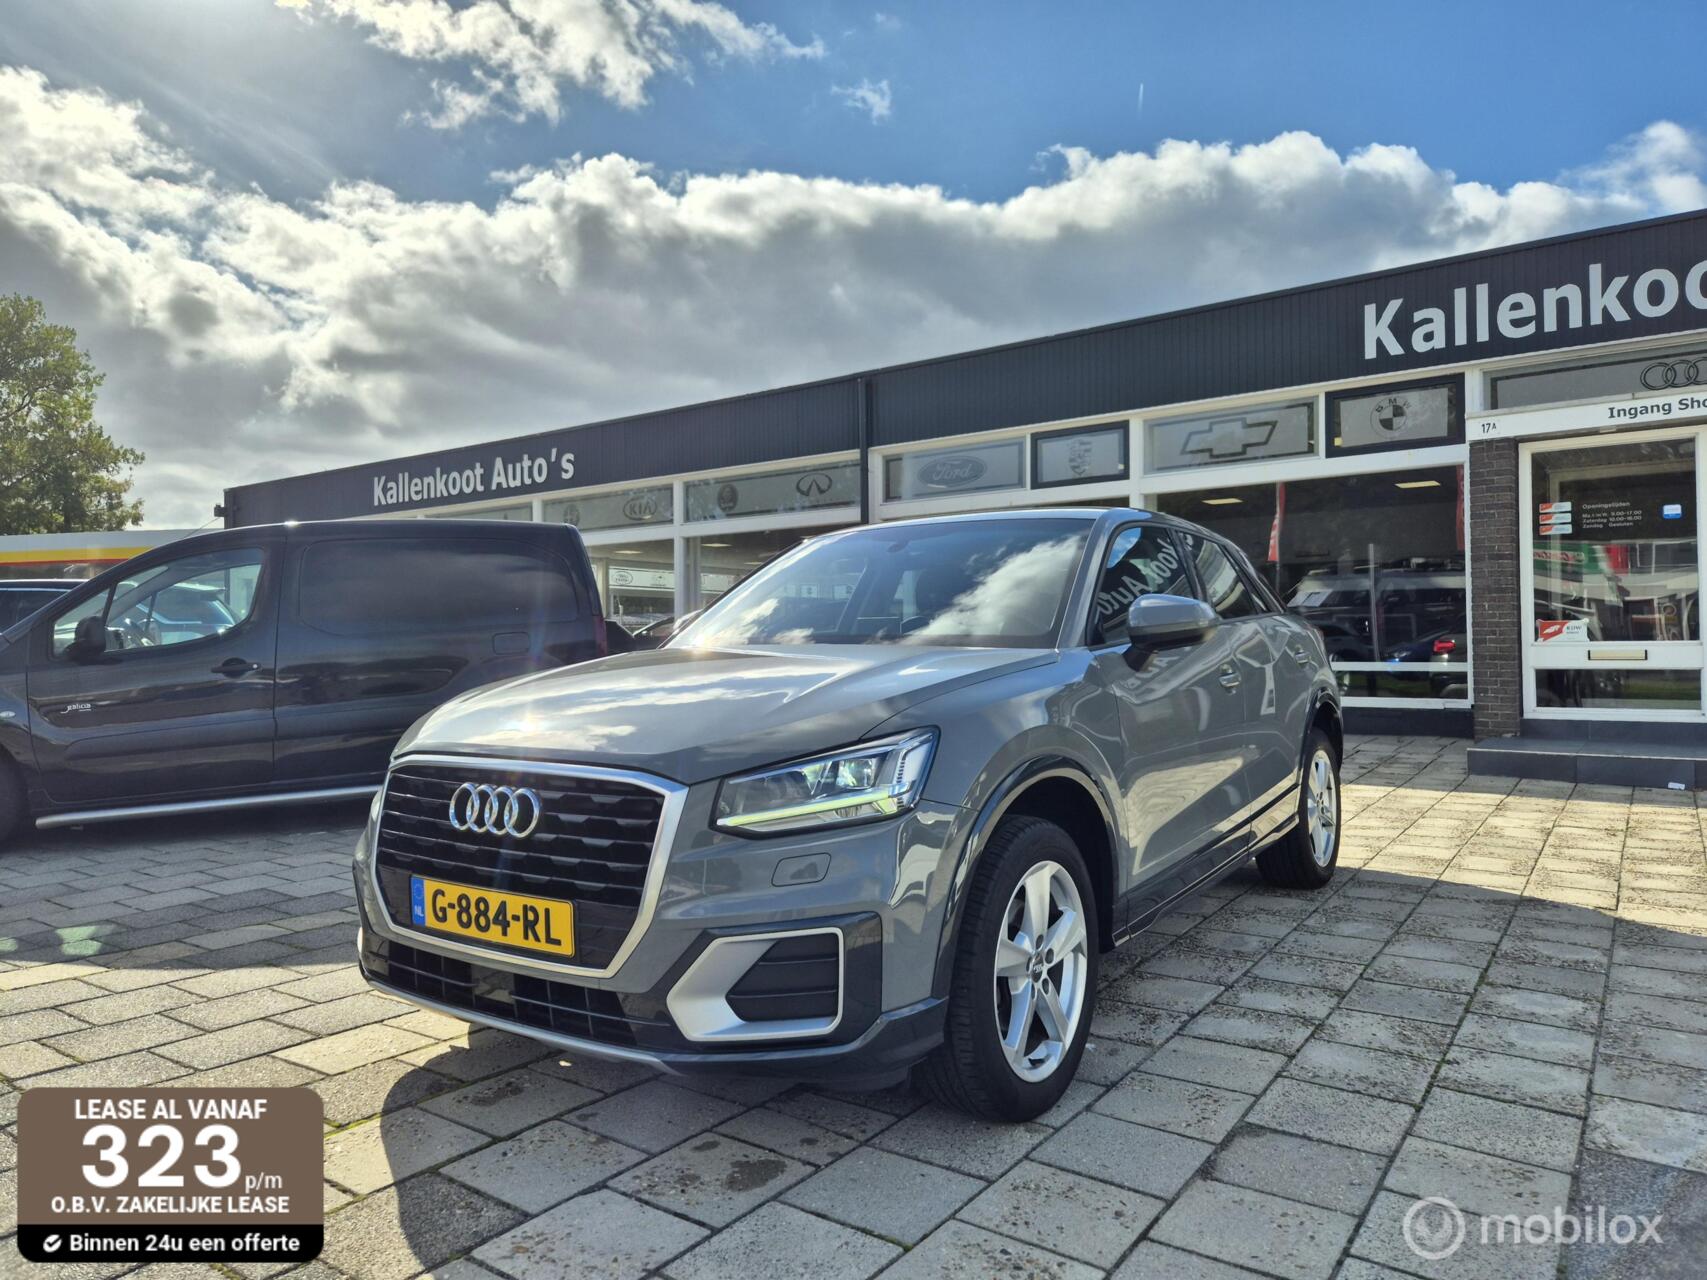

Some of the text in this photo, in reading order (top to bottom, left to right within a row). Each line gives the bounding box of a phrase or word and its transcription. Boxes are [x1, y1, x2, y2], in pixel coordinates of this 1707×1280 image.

[1608, 401, 1672, 419] Ingang
[373, 448, 575, 506] Kallenkoot Auto's
[932, 462, 973, 481] Ford
[629, 503, 651, 515] KIA
[414, 888, 562, 947] NL G-884-RL
